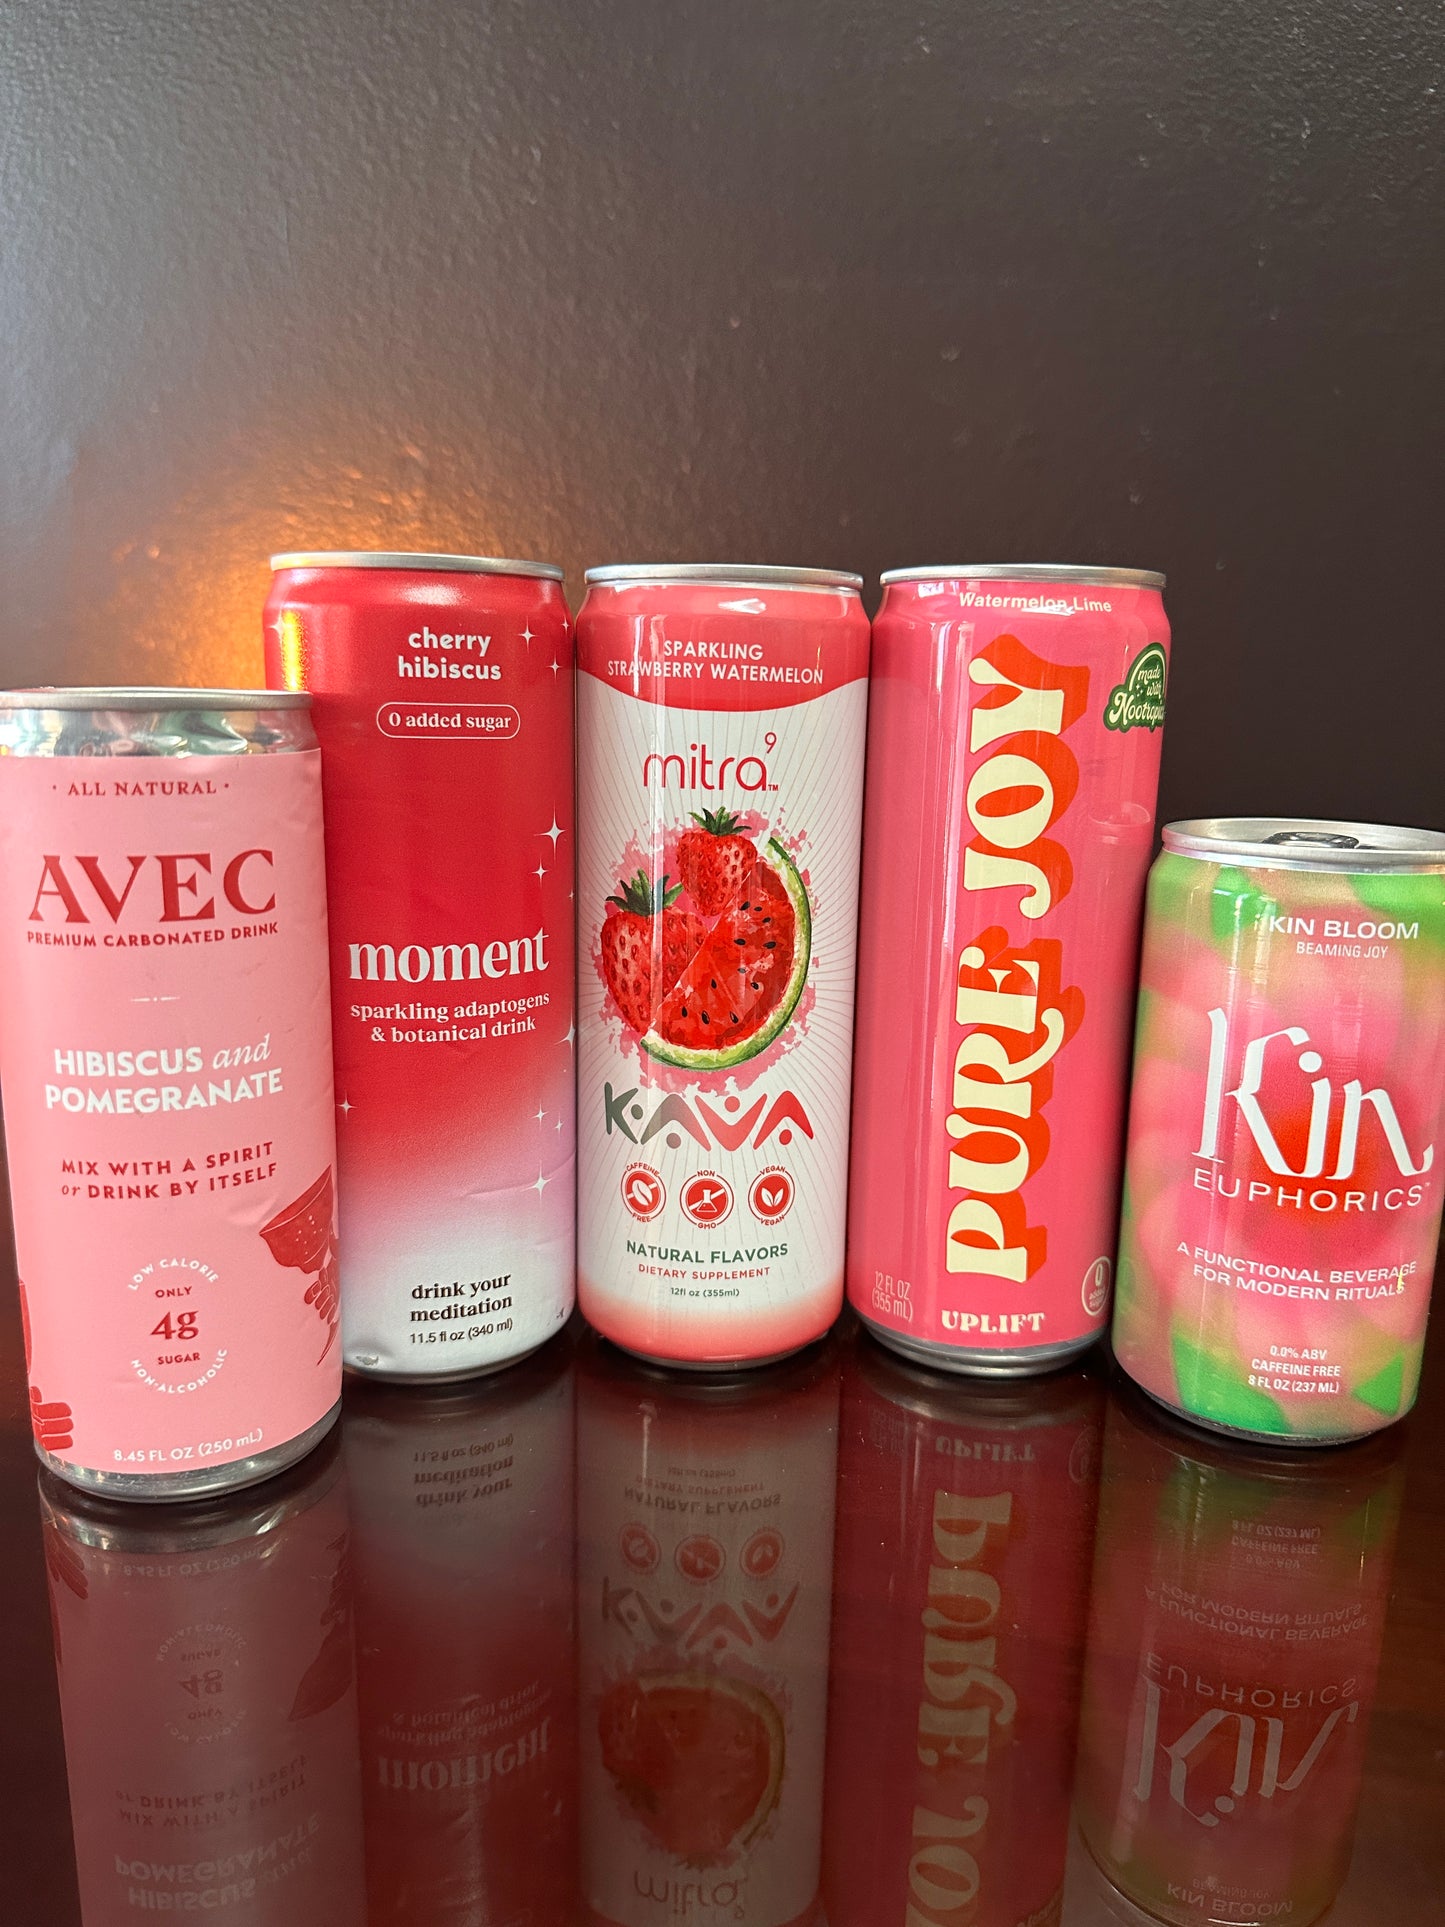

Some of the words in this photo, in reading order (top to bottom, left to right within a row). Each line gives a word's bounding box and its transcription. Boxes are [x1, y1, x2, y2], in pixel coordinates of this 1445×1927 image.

[959, 592, 1067, 610] Watermelon
[1073, 597, 1112, 612] Lime
[408, 626, 492, 657] cherry
[663, 640, 764, 661] SPARKLING
[398, 655, 502, 680] hibiscus
[608, 660, 705, 679] STRAWBERRY
[710, 663, 824, 685] WATERMELON
[388, 712, 401, 727] 0
[405, 713, 462, 728] added
[466, 715, 511, 732] sugar
[67, 781, 106, 796] ALL
[115, 780, 218, 797] NATURAL
[963, 657, 1065, 919] JOY
[28, 848, 277, 924] AVEC
[27, 931, 97, 947] PREMIUM
[103, 929, 226, 947] CARBONATED
[232, 922, 279, 940] DRINK
[1268, 915, 1315, 935] KIN
[1322, 920, 1419, 939] BLOOM
[348, 927, 550, 983] moment
[1296, 942, 1361, 958] BEAMING
[1364, 945, 1389, 959] JOY
[351, 1002, 449, 1023] sparkling
[453, 991, 550, 1019] adaptogens
[371, 1027, 387, 1042] &
[391, 1023, 487, 1043] botanical
[491, 1016, 537, 1037] drink
[54, 1047, 203, 1077] HIBISCUS
[212, 1033, 271, 1070] and
[45, 1068, 284, 1114] POMEGRANATE
[1191, 1007, 1434, 1180] Kin
[604, 1082, 814, 1151] KAVA
[945, 946, 1065, 1282] PURE
[61, 1159, 99, 1176] MIX
[108, 1160, 171, 1176] WITH
[182, 1158, 196, 1172] A
[206, 1141, 273, 1169] SPIRIT
[626, 1162, 660, 1177] CAFFEINE
[760, 1165, 786, 1176] VEGAN
[62, 1184, 81, 1197] or
[87, 1184, 161, 1200] DRINK
[170, 1180, 200, 1197] BY
[209, 1162, 278, 1191] ITSELF
[697, 1169, 716, 1178] NON
[1193, 1167, 1423, 1212] EUPHORICS
[632, 1212, 651, 1223] FREE
[697, 1222, 717, 1230] GMO
[759, 1214, 786, 1226] VEGAN
[627, 1240, 704, 1263] NATURAL
[710, 1243, 788, 1264] FLAVORS
[1177, 1241, 1190, 1256] A
[1194, 1246, 1323, 1283] FUNCTIONAL
[1330, 1261, 1417, 1284] BEVERAGE
[128, 1263, 154, 1292] LOW
[160, 1258, 219, 1283] CALORIE
[638, 1264, 687, 1279] DIETARY
[692, 1266, 771, 1280] SUPPLEMENT
[1193, 1263, 1231, 1286] FOR
[1236, 1277, 1330, 1301] MODERN
[1335, 1281, 1405, 1301] RITUALS
[155, 1286, 193, 1298] ONLY
[411, 1281, 465, 1300] drink
[470, 1274, 512, 1297] your
[670, 1287, 686, 1296] 12fl
[689, 1289, 700, 1297] oz
[703, 1288, 740, 1298] (355ml)
[875, 1271, 883, 1290] 12
[885, 1274, 894, 1293] FL
[897, 1279, 911, 1300] OZ
[410, 1295, 513, 1323] meditation
[941, 1310, 1045, 1333] UPLIFT
[150, 1310, 199, 1340] 4g
[410, 1332, 437, 1344] 11.5
[439, 1330, 447, 1342] fl
[450, 1331, 465, 1342] oz
[468, 1323, 494, 1341] (340
[496, 1317, 513, 1332] ml)
[158, 1352, 201, 1365] SUGAR
[1269, 1345, 1299, 1359] 0.0%
[1301, 1348, 1327, 1360] ABV
[1251, 1358, 1311, 1376] CAFFEINE
[1313, 1365, 1341, 1377] FREE
[1248, 1375, 1255, 1386] 8
[1257, 1377, 1271, 1389] FL
[1274, 1379, 1290, 1390] OZ
[1292, 1380, 1316, 1393] (237
[1318, 1381, 1340, 1394] ML)
[113, 1448, 145, 1463] 8.45
[149, 1448, 166, 1462] FL
[170, 1446, 195, 1461] OZ
[198, 1438, 233, 1458] (250
[237, 1427, 264, 1448] mL)
